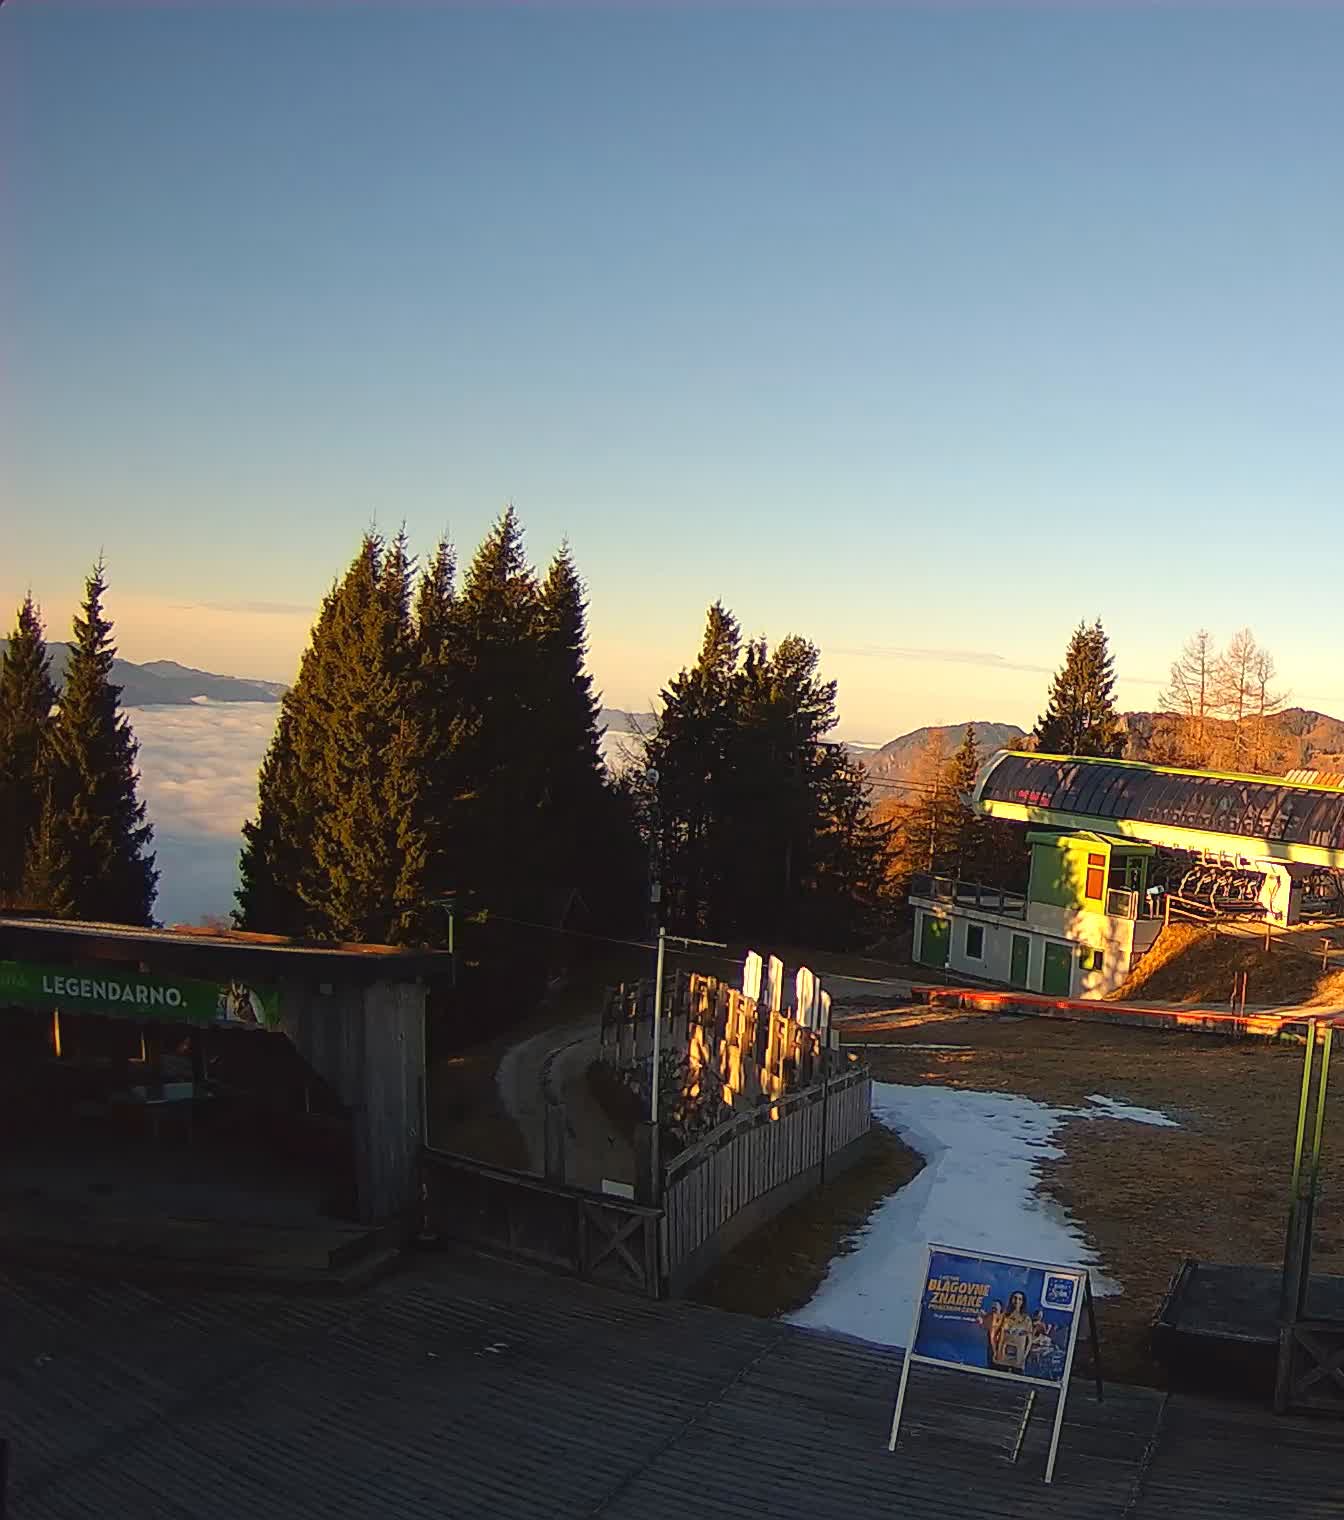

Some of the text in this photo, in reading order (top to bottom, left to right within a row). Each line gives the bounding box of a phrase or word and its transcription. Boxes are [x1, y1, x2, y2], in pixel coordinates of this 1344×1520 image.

[42, 975, 188, 1008] LEGENDARNO.
[928, 1279, 992, 1297] BLAGOVNE
[930, 1292, 984, 1308] ZNAMKE
